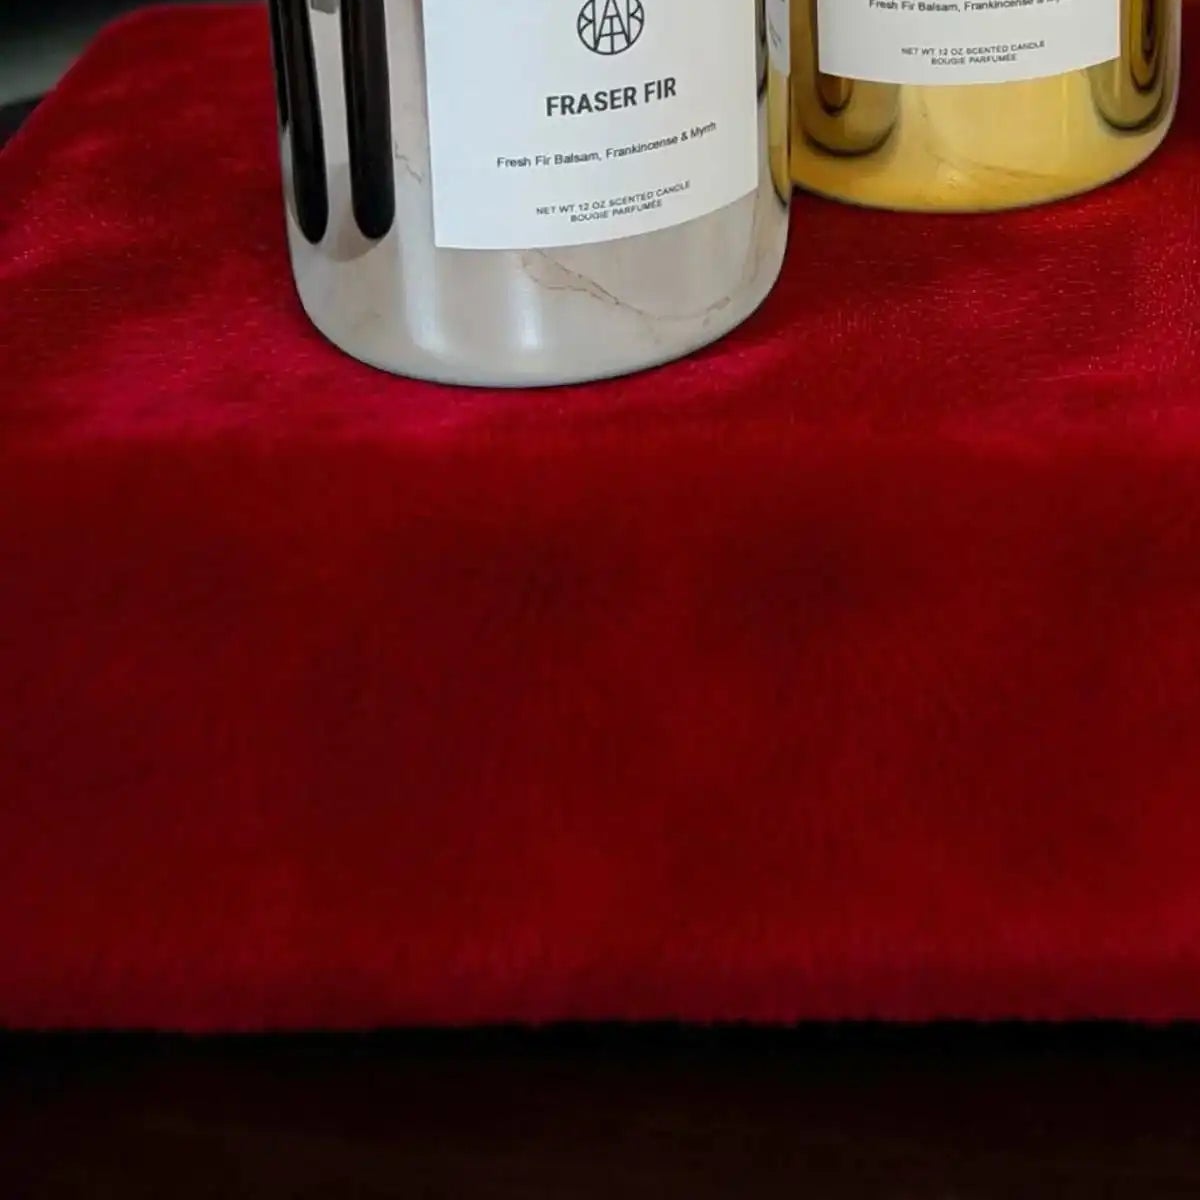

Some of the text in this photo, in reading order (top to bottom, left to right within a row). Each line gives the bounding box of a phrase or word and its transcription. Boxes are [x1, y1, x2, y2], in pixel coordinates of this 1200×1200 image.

[901, 0, 914, 10] Fir
[918, 0, 961, 13] Balsam,
[966, 46, 1008, 54] SCENTED
[1011, 41, 1044, 52] CANDLE
[546, 77, 676, 116] FRASER FIR
[497, 121, 717, 168] Fresh Fir Balsam, Frankincense & Myrrh
[536, 181, 690, 215] NET WT 12 OZ SCENTED CANDLE
[570, 211, 609, 222] BOUGIE
